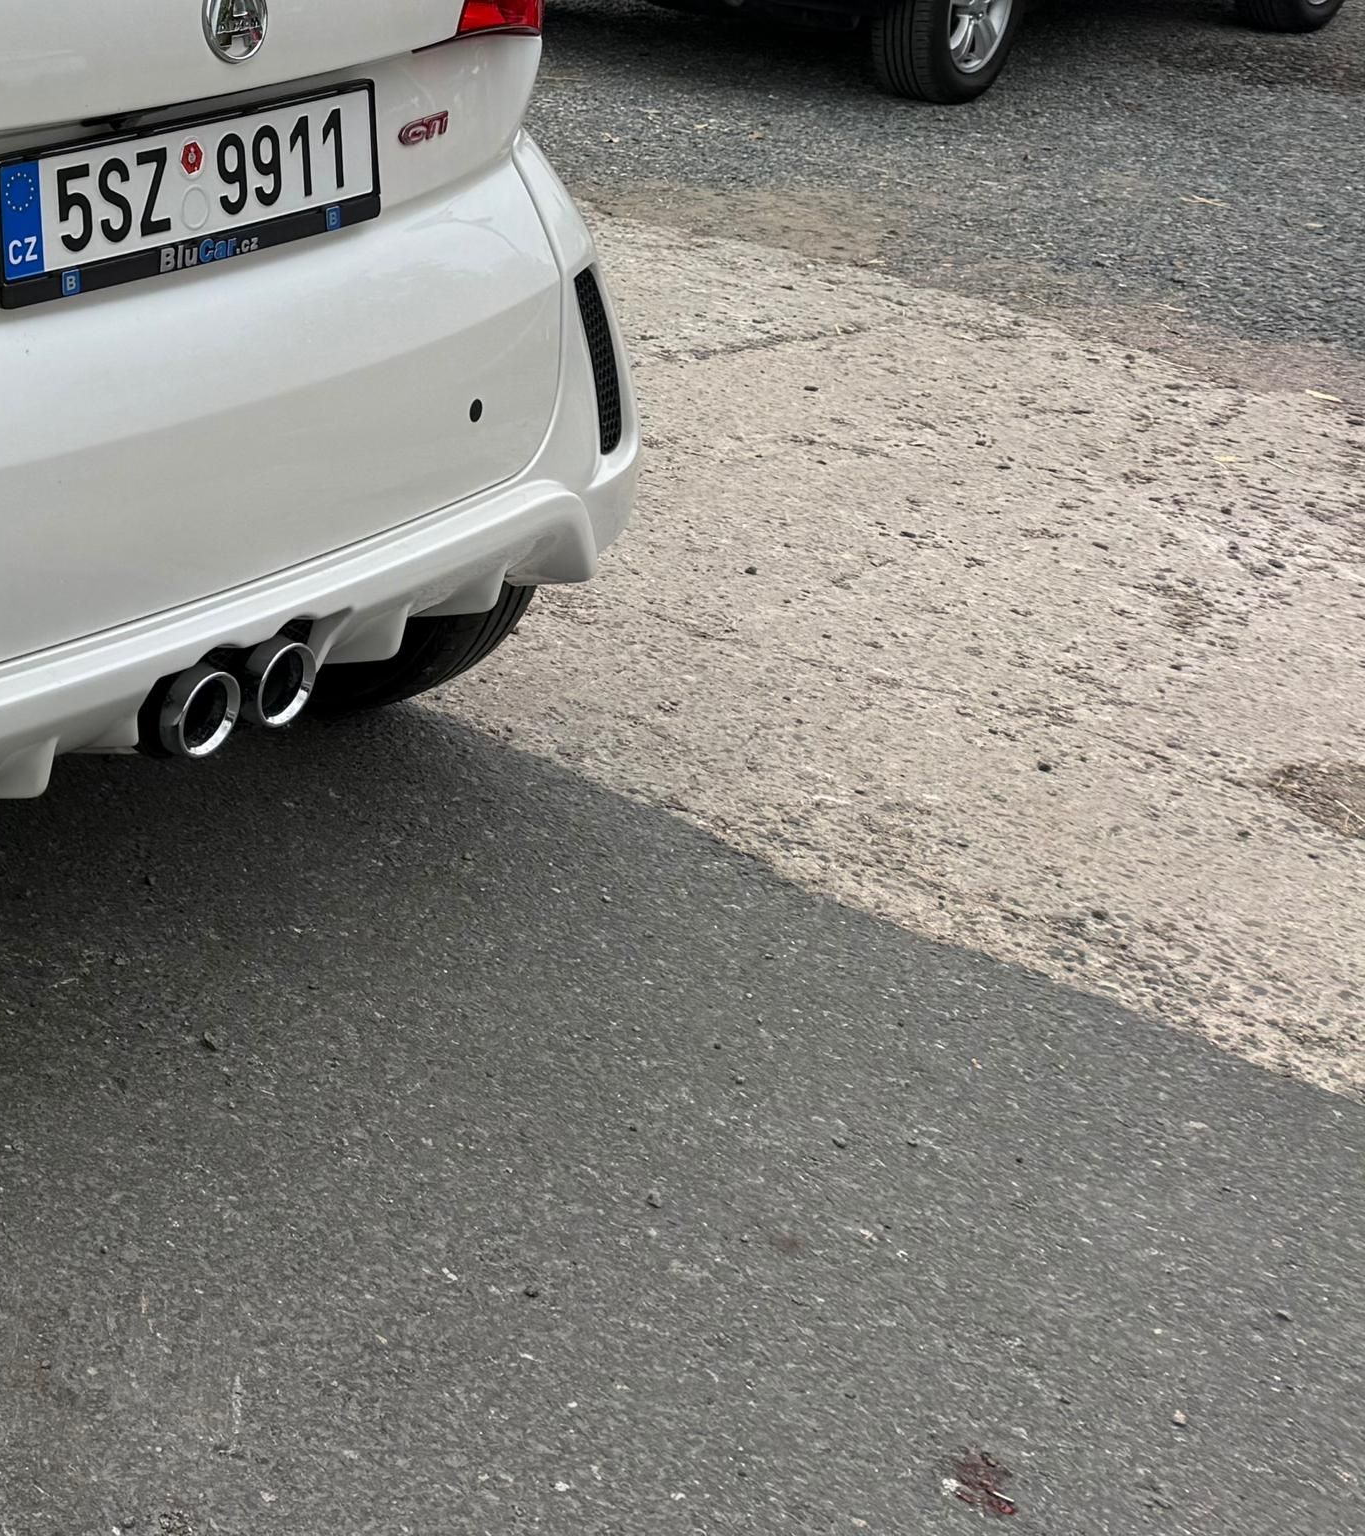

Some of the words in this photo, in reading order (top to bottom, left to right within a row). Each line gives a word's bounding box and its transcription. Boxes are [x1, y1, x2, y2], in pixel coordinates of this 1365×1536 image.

[397, 110, 449, 146] GTI
[55, 146, 172, 253] 5SZ
[217, 107, 345, 216] 9911
[7, 235, 39, 265] CZ
[159, 237, 259, 273] BluCar.cz
